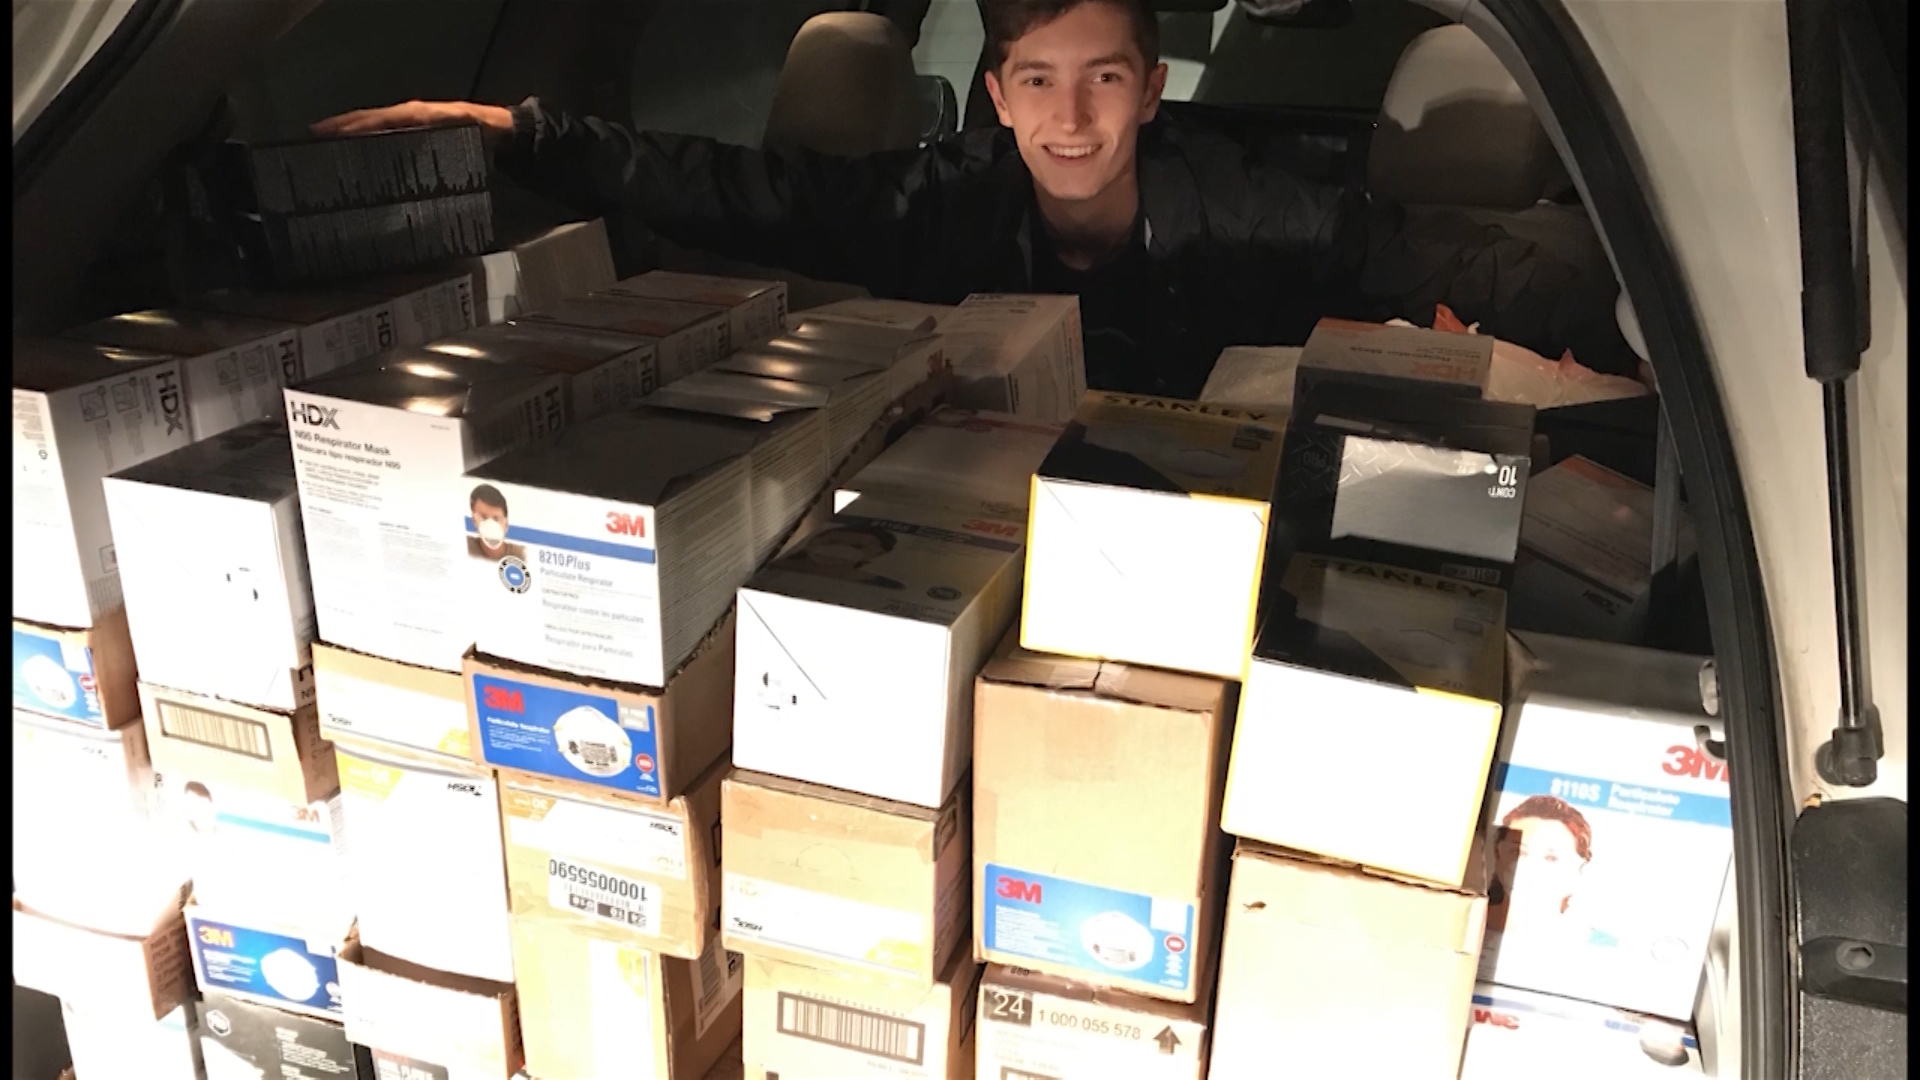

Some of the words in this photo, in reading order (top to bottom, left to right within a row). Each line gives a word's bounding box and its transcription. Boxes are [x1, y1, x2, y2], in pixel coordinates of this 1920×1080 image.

[376, 310, 392, 350] HD
[156, 370, 183, 436] HDX
[290, 400, 341, 430] HDX
[1103, 394, 1267, 421] STANLEY
[1498, 465, 1518, 486] 10
[605, 511, 646, 538] 3M
[1309, 558, 1486, 598] STANLEY
[483, 684, 525, 714] 3M
[1662, 744, 1731, 784] 3M
[1550, 777, 1602, 803] 8110S
[1609, 782, 1681, 806] Particulate
[1607, 798, 1676, 817] Respirator
[549, 859, 649, 902] 1000055590
[995, 876, 1043, 904] 3M
[198, 925, 235, 948] 3M
[991, 990, 1026, 1020] 24
[1038, 1009, 1046, 1022] 1
[1050, 1012, 1078, 1028] 000
[1082, 1017, 1110, 1034] 055
[1113, 1023, 1142, 1040] 578
